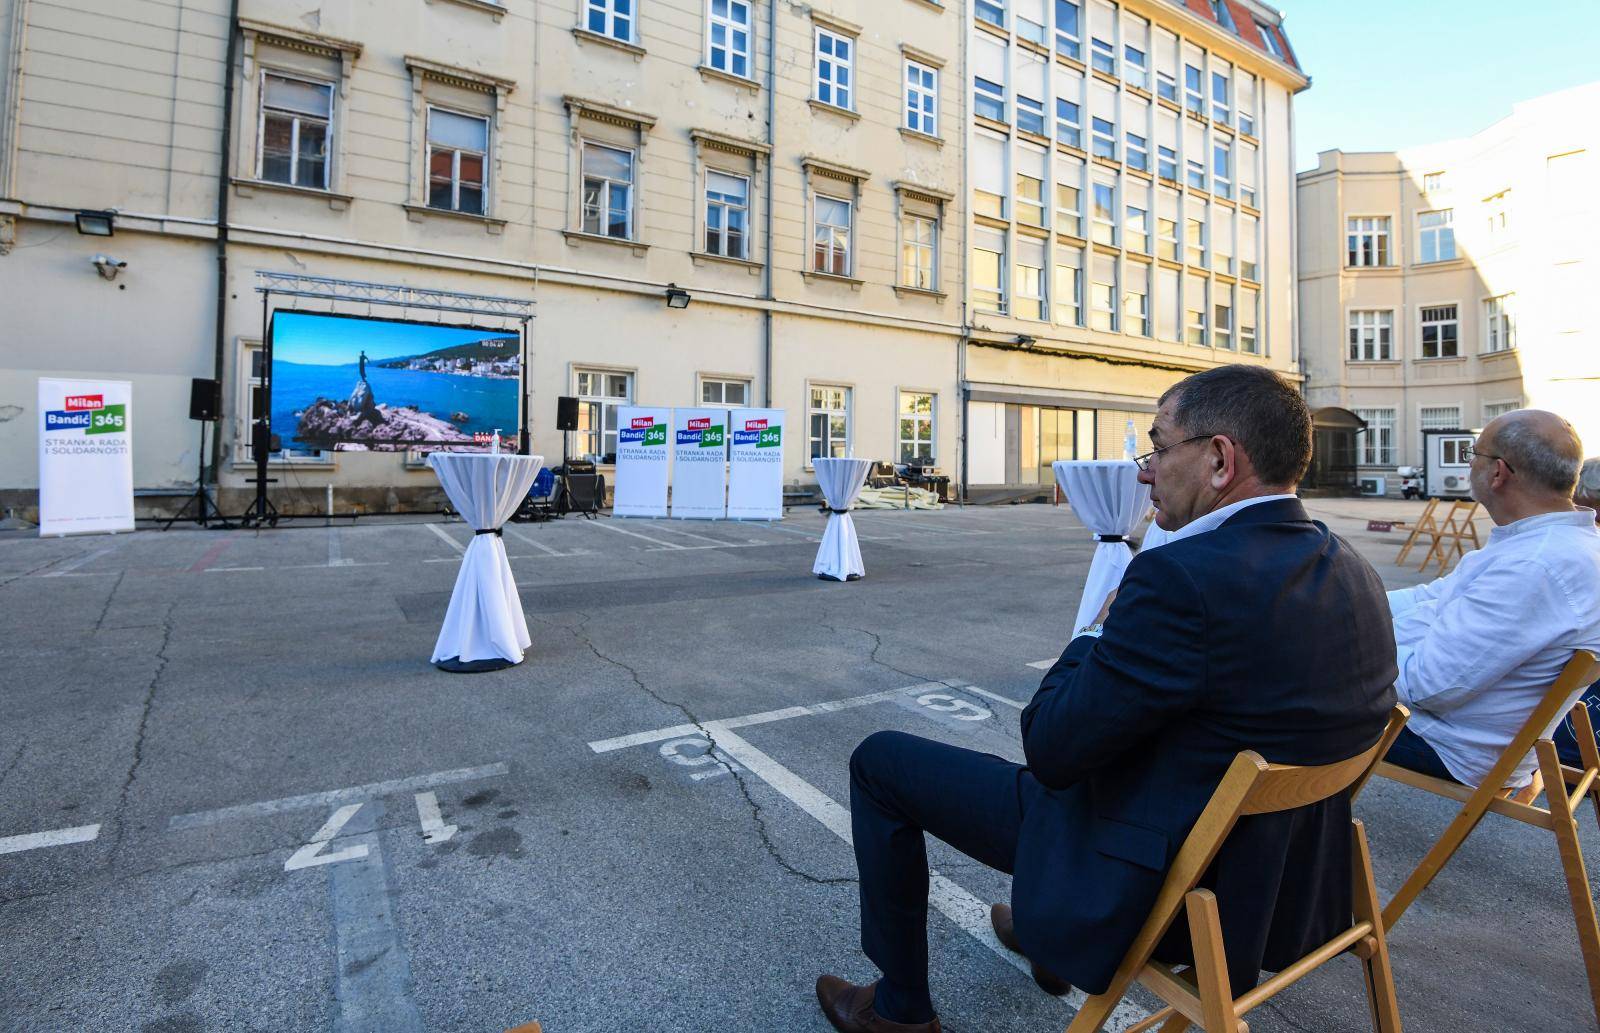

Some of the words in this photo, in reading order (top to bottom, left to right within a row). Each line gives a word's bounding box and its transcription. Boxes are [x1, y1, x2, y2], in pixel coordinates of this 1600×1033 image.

[68, 398, 102, 407] Milan
[47, 414, 90, 424] Bandić
[95, 413, 124, 426] 365
[633, 419, 652, 427] Milan
[689, 420, 709, 428] Milan
[746, 421, 767, 429] Milan
[621, 431, 645, 439] Bandić
[648, 430, 665, 440] 365
[677, 432, 702, 440] Bandić
[705, 431, 722, 442] 365
[735, 433, 759, 441] Bandić
[762, 432, 779, 443] 365
[52, 447, 127, 455] SOLIDARNOSTI
[680, 455, 724, 463] SOLIDARNOSTI
